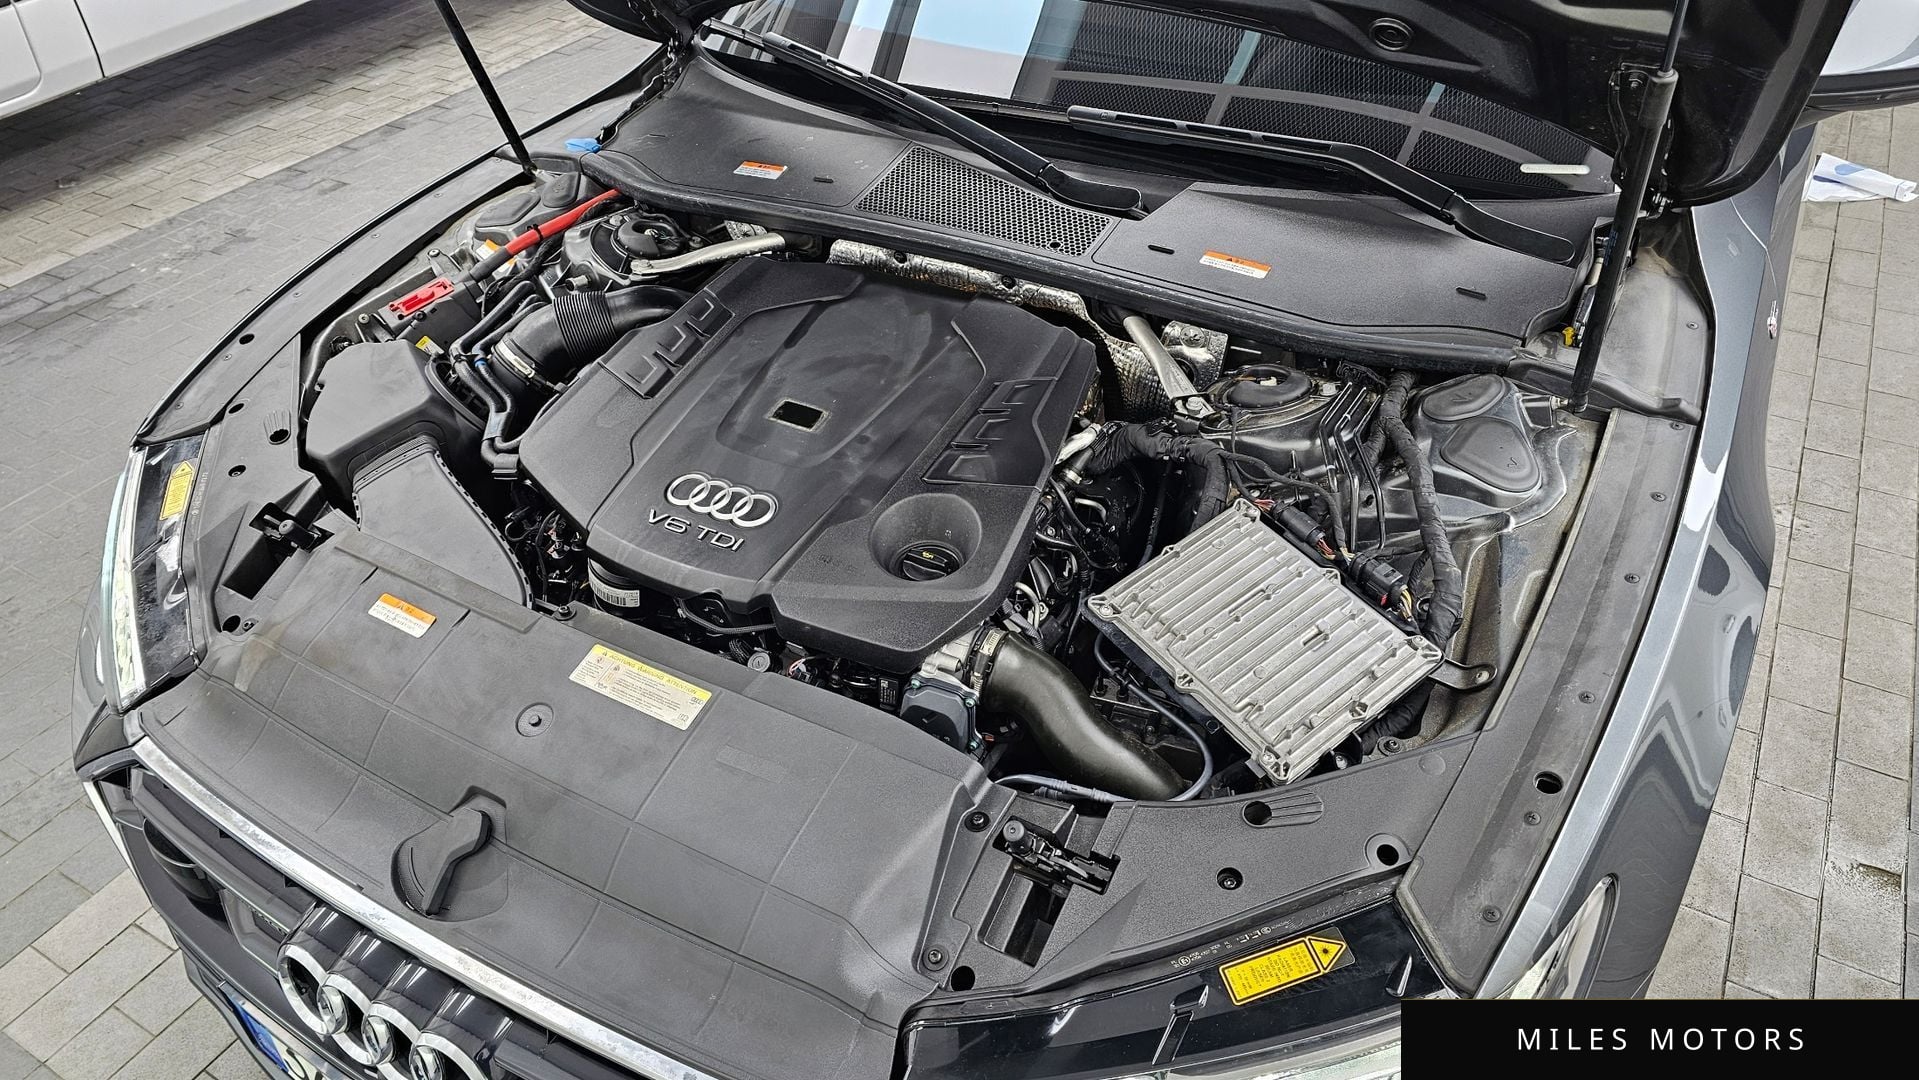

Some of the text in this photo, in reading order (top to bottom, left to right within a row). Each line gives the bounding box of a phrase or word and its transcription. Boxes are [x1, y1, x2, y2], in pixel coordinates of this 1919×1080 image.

[649, 509, 745, 552] V6 TDI
[609, 653, 636, 668] ACHTUNG
[666, 678, 698, 694] ATTENTION
